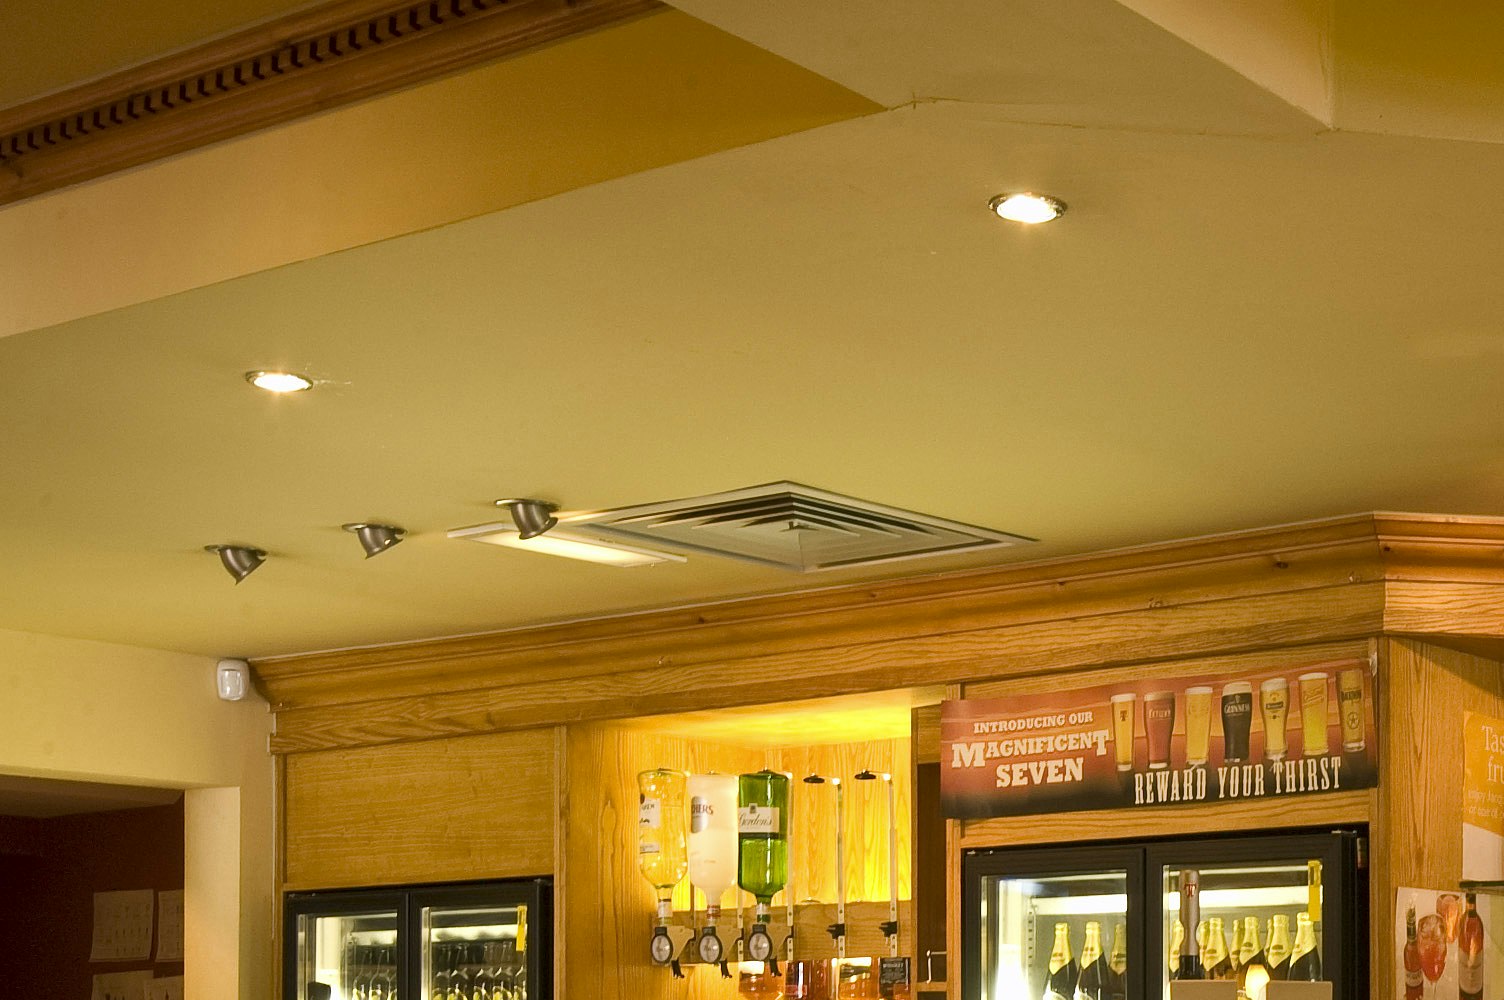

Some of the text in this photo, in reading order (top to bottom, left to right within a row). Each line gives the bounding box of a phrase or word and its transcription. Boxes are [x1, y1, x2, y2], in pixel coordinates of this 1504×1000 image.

[973, 711, 1094, 734] INTRODUCING OUR
[951, 728, 1111, 769] MAGNIFICENT
[995, 756, 1085, 788] SEVEN
[1134, 755, 1342, 805] REWARD YOUR THIRST
